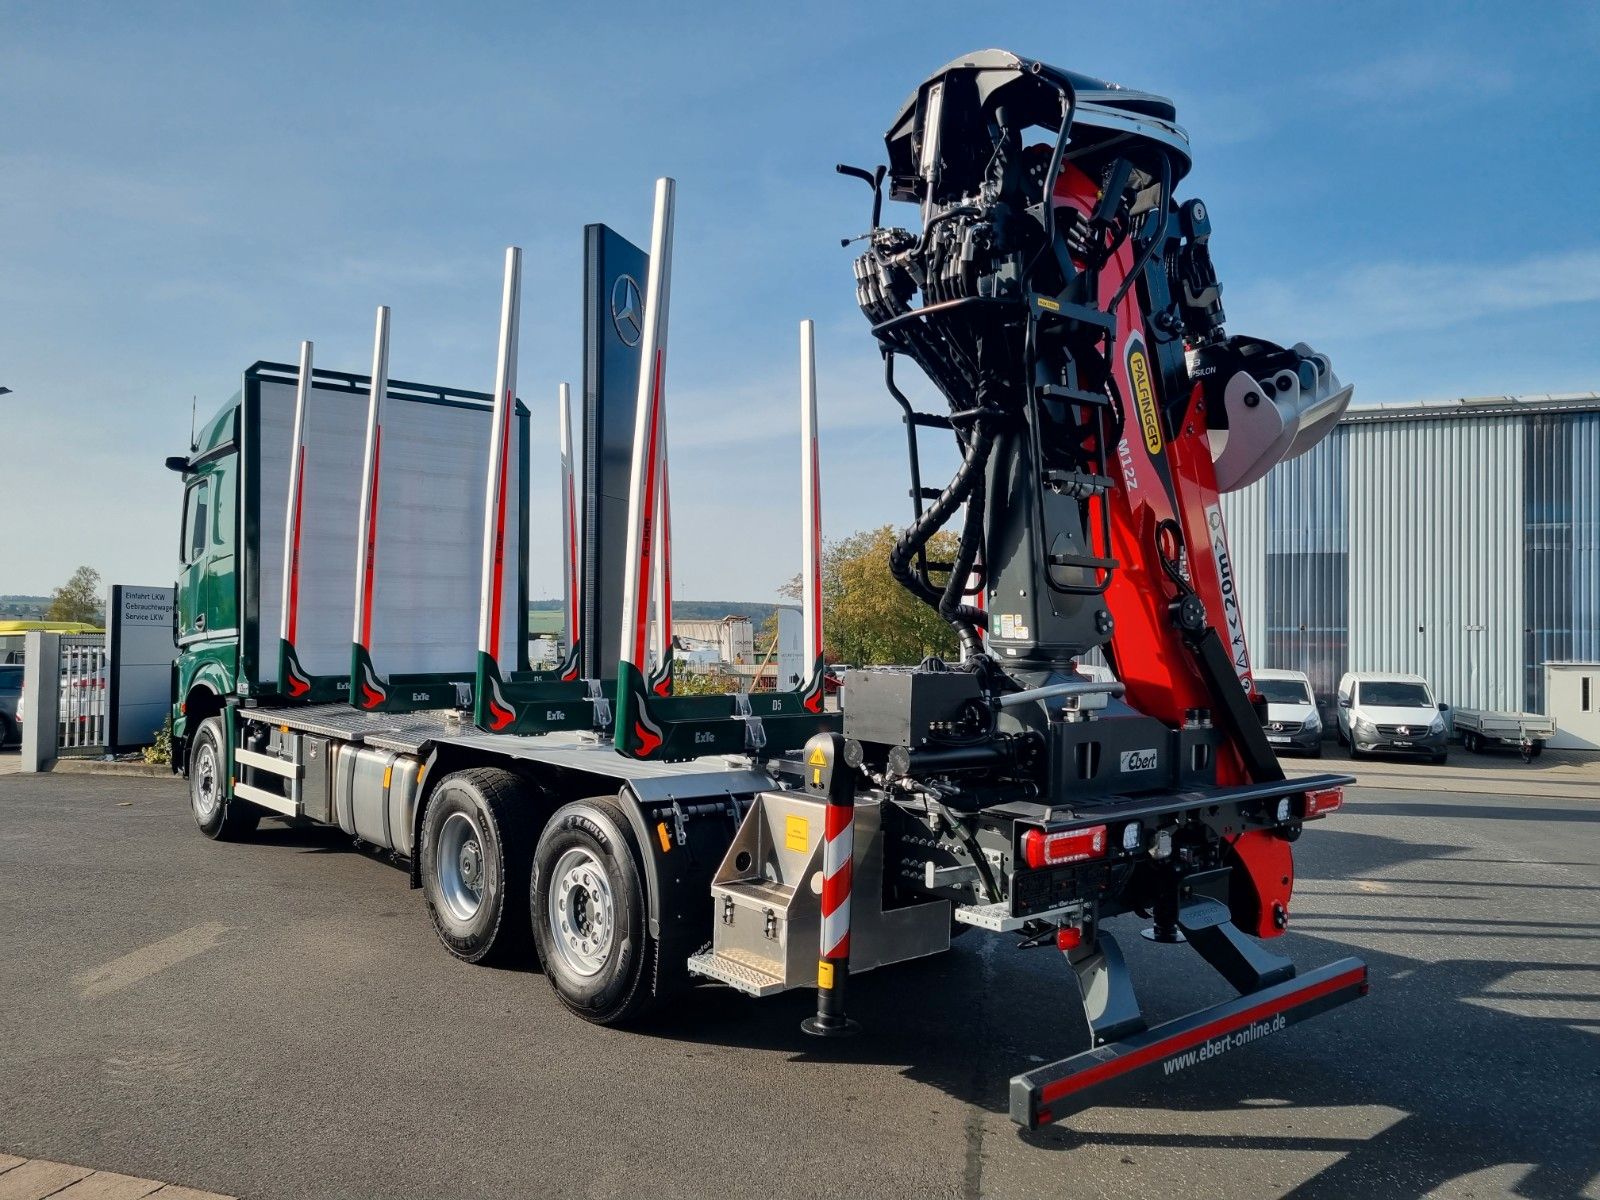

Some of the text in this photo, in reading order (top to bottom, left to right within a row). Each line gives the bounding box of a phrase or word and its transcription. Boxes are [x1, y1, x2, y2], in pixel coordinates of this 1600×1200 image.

[1188, 366, 1217, 379] PSILON
[1131, 357, 1160, 448] PALFINGER
[1118, 438, 1138, 493] M12Z
[1218, 552, 1237, 612] 20m
[125, 592, 166, 601] Einfahrt LKW
[125, 602, 173, 613] Gebrauchtwage
[125, 612, 165, 621] Service LKW
[412, 692, 430, 702] ExTe
[772, 700, 782, 711] D5
[546, 710, 567, 721] ExTe
[695, 732, 715, 743] ExTe
[1128, 751, 1156, 770] Ebert
[1162, 1012, 1287, 1076] www.ebert-online.de
